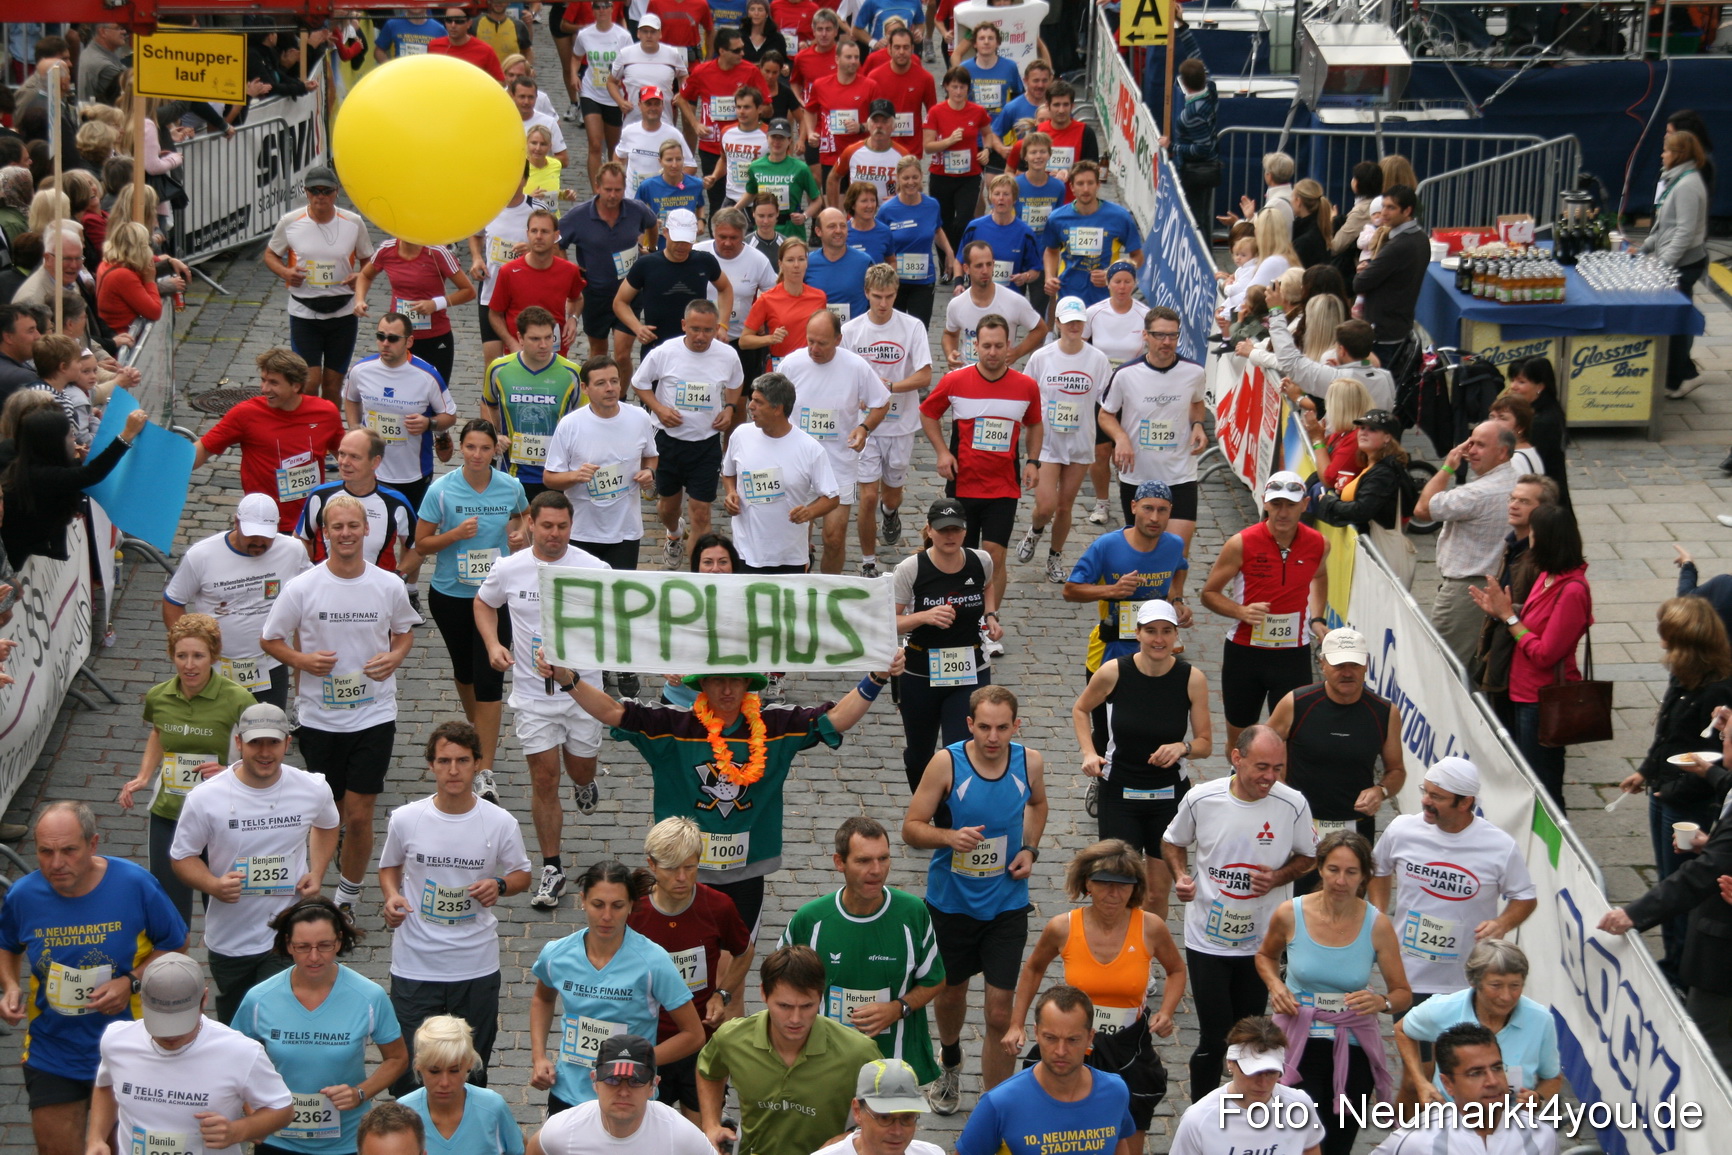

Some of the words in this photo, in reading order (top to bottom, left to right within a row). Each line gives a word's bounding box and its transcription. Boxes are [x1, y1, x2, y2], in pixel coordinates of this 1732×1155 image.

[1132, 0, 1162, 27] A
[142, 44, 239, 66] Schnupper-
[175, 67, 206, 83] lauf
[718, 105, 736, 114] 3563
[725, 143, 762, 153] MERZ
[952, 158, 969, 166] 3514
[1051, 156, 1071, 165] 2970
[856, 165, 897, 176] MERZ
[754, 173, 795, 184] Sinupret
[1078, 238, 1099, 246] 2471
[905, 263, 925, 271] 3832
[322, 272, 334, 280] 61
[857, 346, 894, 354] GERHART
[1571, 339, 1653, 379] Glossner
[1612, 361, 1649, 377] Bier
[1046, 376, 1086, 384] GERHART
[510, 394, 558, 405] BOCK
[687, 392, 711, 402] 3144
[1057, 413, 1079, 423] 2414
[382, 425, 402, 435] 363
[811, 420, 836, 431] 3146
[523, 437, 541, 445] Stefan
[985, 431, 1008, 441] 2804
[1151, 431, 1175, 441] 3129
[526, 446, 547, 457] 613
[291, 475, 317, 488] 2582
[599, 475, 624, 490] 3147
[756, 480, 781, 492] 3145
[469, 552, 488, 560] Nadine
[923, 596, 945, 607] Radl
[947, 593, 982, 608] Express
[554, 577, 871, 665] APPLAUS
[1266, 616, 1289, 624] Werner
[1269, 626, 1292, 637] 438
[942, 651, 958, 660] Tanja
[232, 660, 254, 670] Günter
[944, 661, 972, 673] 2903
[238, 668, 261, 682] 941
[337, 684, 367, 698] 2367
[164, 723, 184, 734] EURO
[190, 727, 213, 737] POLES
[242, 817, 266, 827] TELIS
[269, 815, 302, 826] FINANZ
[270, 822, 302, 830] ACHHAMMER
[1319, 819, 1346, 829] Norbert
[710, 833, 733, 842] Bernd
[711, 844, 744, 857] 1000
[252, 855, 286, 866] Benjamin
[454, 857, 486, 866] FINANZ
[972, 853, 998, 865] 929
[252, 867, 289, 882] 2352
[1208, 867, 1250, 882] GERHAR
[1406, 862, 1466, 884] GERHART
[438, 888, 464, 898] Michael
[437, 900, 472, 912] 2353
[1224, 911, 1252, 922] Andreas
[34, 929, 44, 938] 10.
[46, 921, 122, 937] NEUMARKTER
[1223, 922, 1255, 935] 2423
[1422, 918, 1444, 931] Oliver
[44, 933, 107, 948] STADTLAUF
[1420, 931, 1456, 949] 2422
[64, 971, 82, 983] Rudi
[573, 991, 599, 999] DIREKTION
[574, 984, 598, 994] TELIS
[600, 986, 633, 997] FINANZ
[846, 992, 876, 1003] Herbert
[1095, 1009, 1111, 1020] Tina
[581, 1021, 609, 1035] Melanie
[283, 1031, 310, 1040] TELIS
[314, 1032, 351, 1041] FINANZ
[135, 1086, 164, 1098] TELIS
[167, 1090, 210, 1102] FINANZ
[134, 1095, 167, 1104] DIREKTION
[168, 1099, 209, 1107] ACHHAMMER
[291, 1096, 320, 1107] Claudia
[758, 1101, 782, 1111] EURO
[790, 1103, 816, 1116] POLES
[292, 1110, 332, 1124] 2362
[149, 1136, 176, 1147] Danilo
[1024, 1134, 1040, 1146] 10.
[1042, 1126, 1116, 1144] NEUMARKTER
[1041, 1138, 1106, 1155] STADTLAUF
